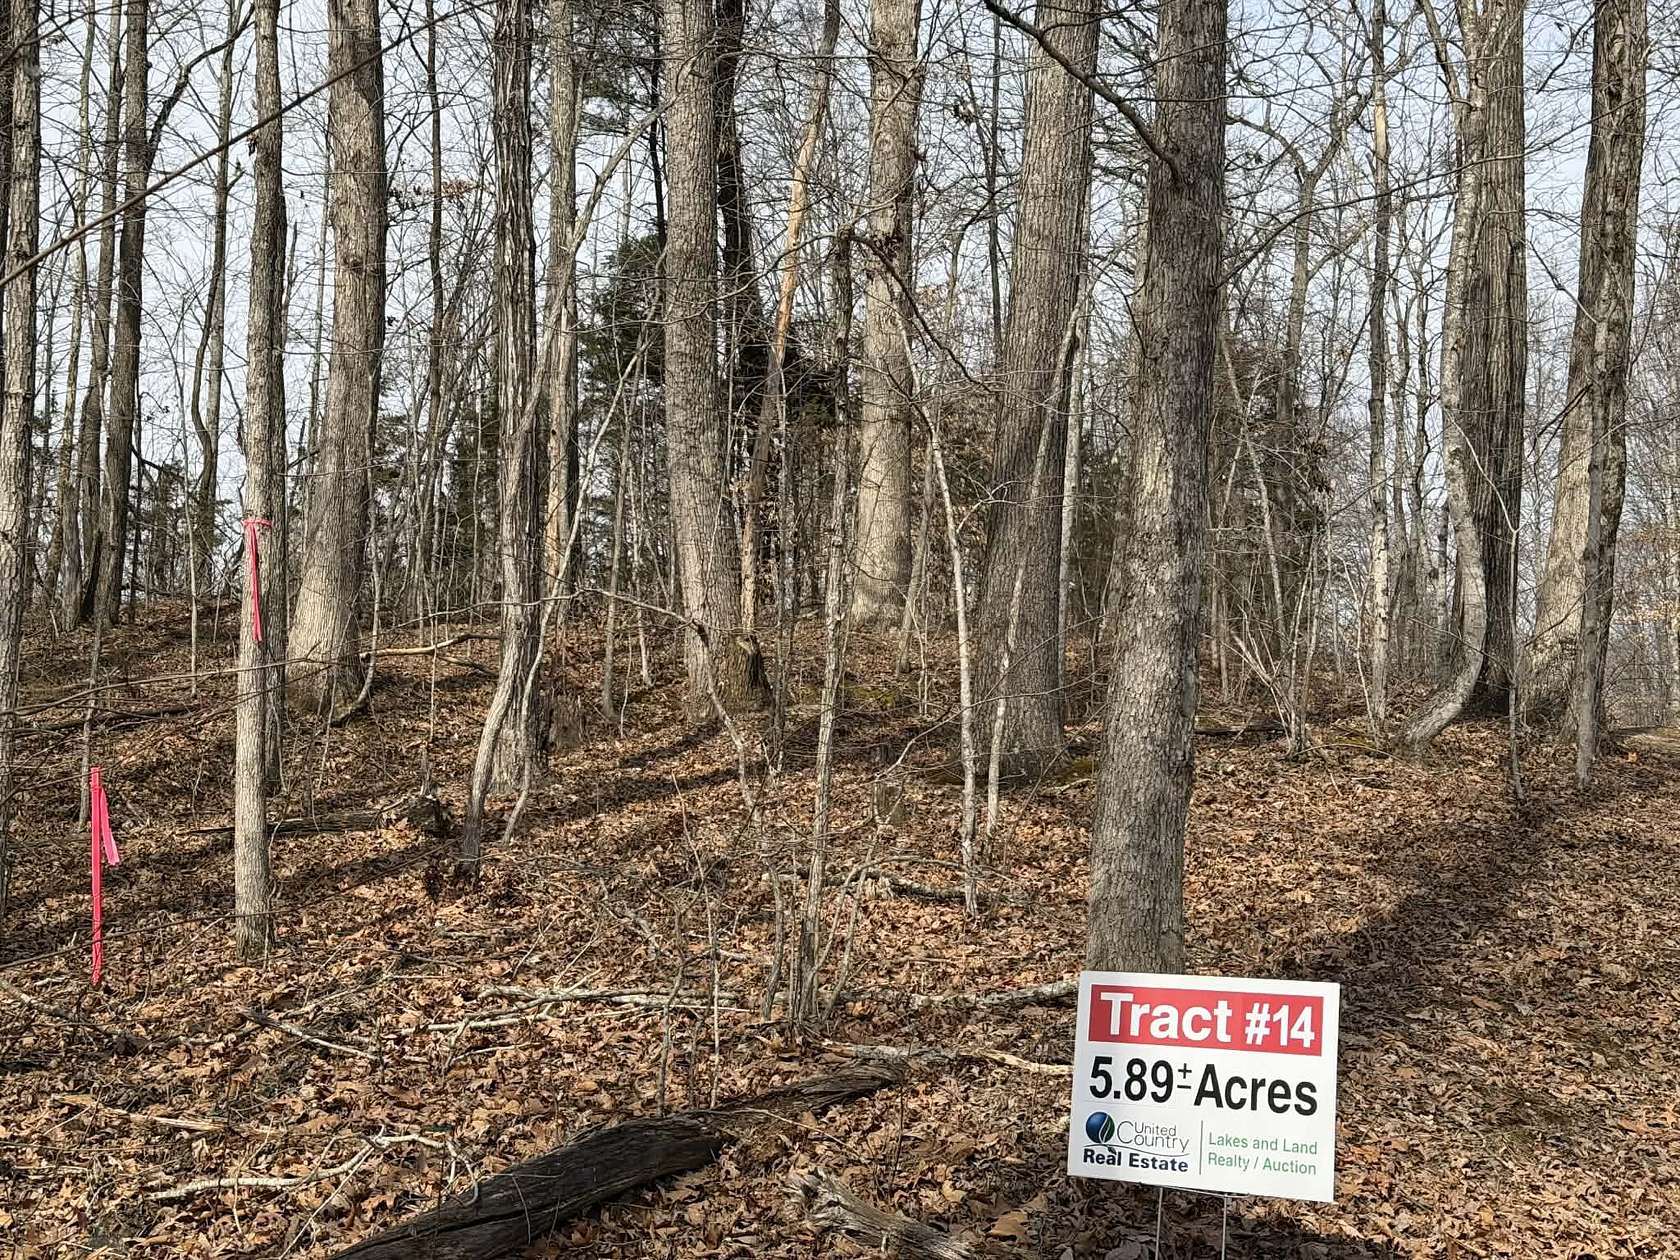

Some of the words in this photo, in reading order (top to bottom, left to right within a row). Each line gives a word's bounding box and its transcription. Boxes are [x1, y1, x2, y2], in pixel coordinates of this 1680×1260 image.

[1100, 992, 1232, 1043] Tract
[1244, 1002, 1315, 1048] #14
[1193, 1063, 1318, 1116] Acres
[1116, 1120, 1190, 1153] Country
[1134, 1121, 1177, 1137] United
[1208, 1132, 1249, 1148] Lakes
[1252, 1135, 1278, 1151] and
[1283, 1139, 1318, 1155] Land
[1083, 1148, 1122, 1167] Real
[1128, 1153, 1189, 1173] Estate
[1208, 1152, 1250, 1172] Realty
[1262, 1158, 1317, 1176] Auction
